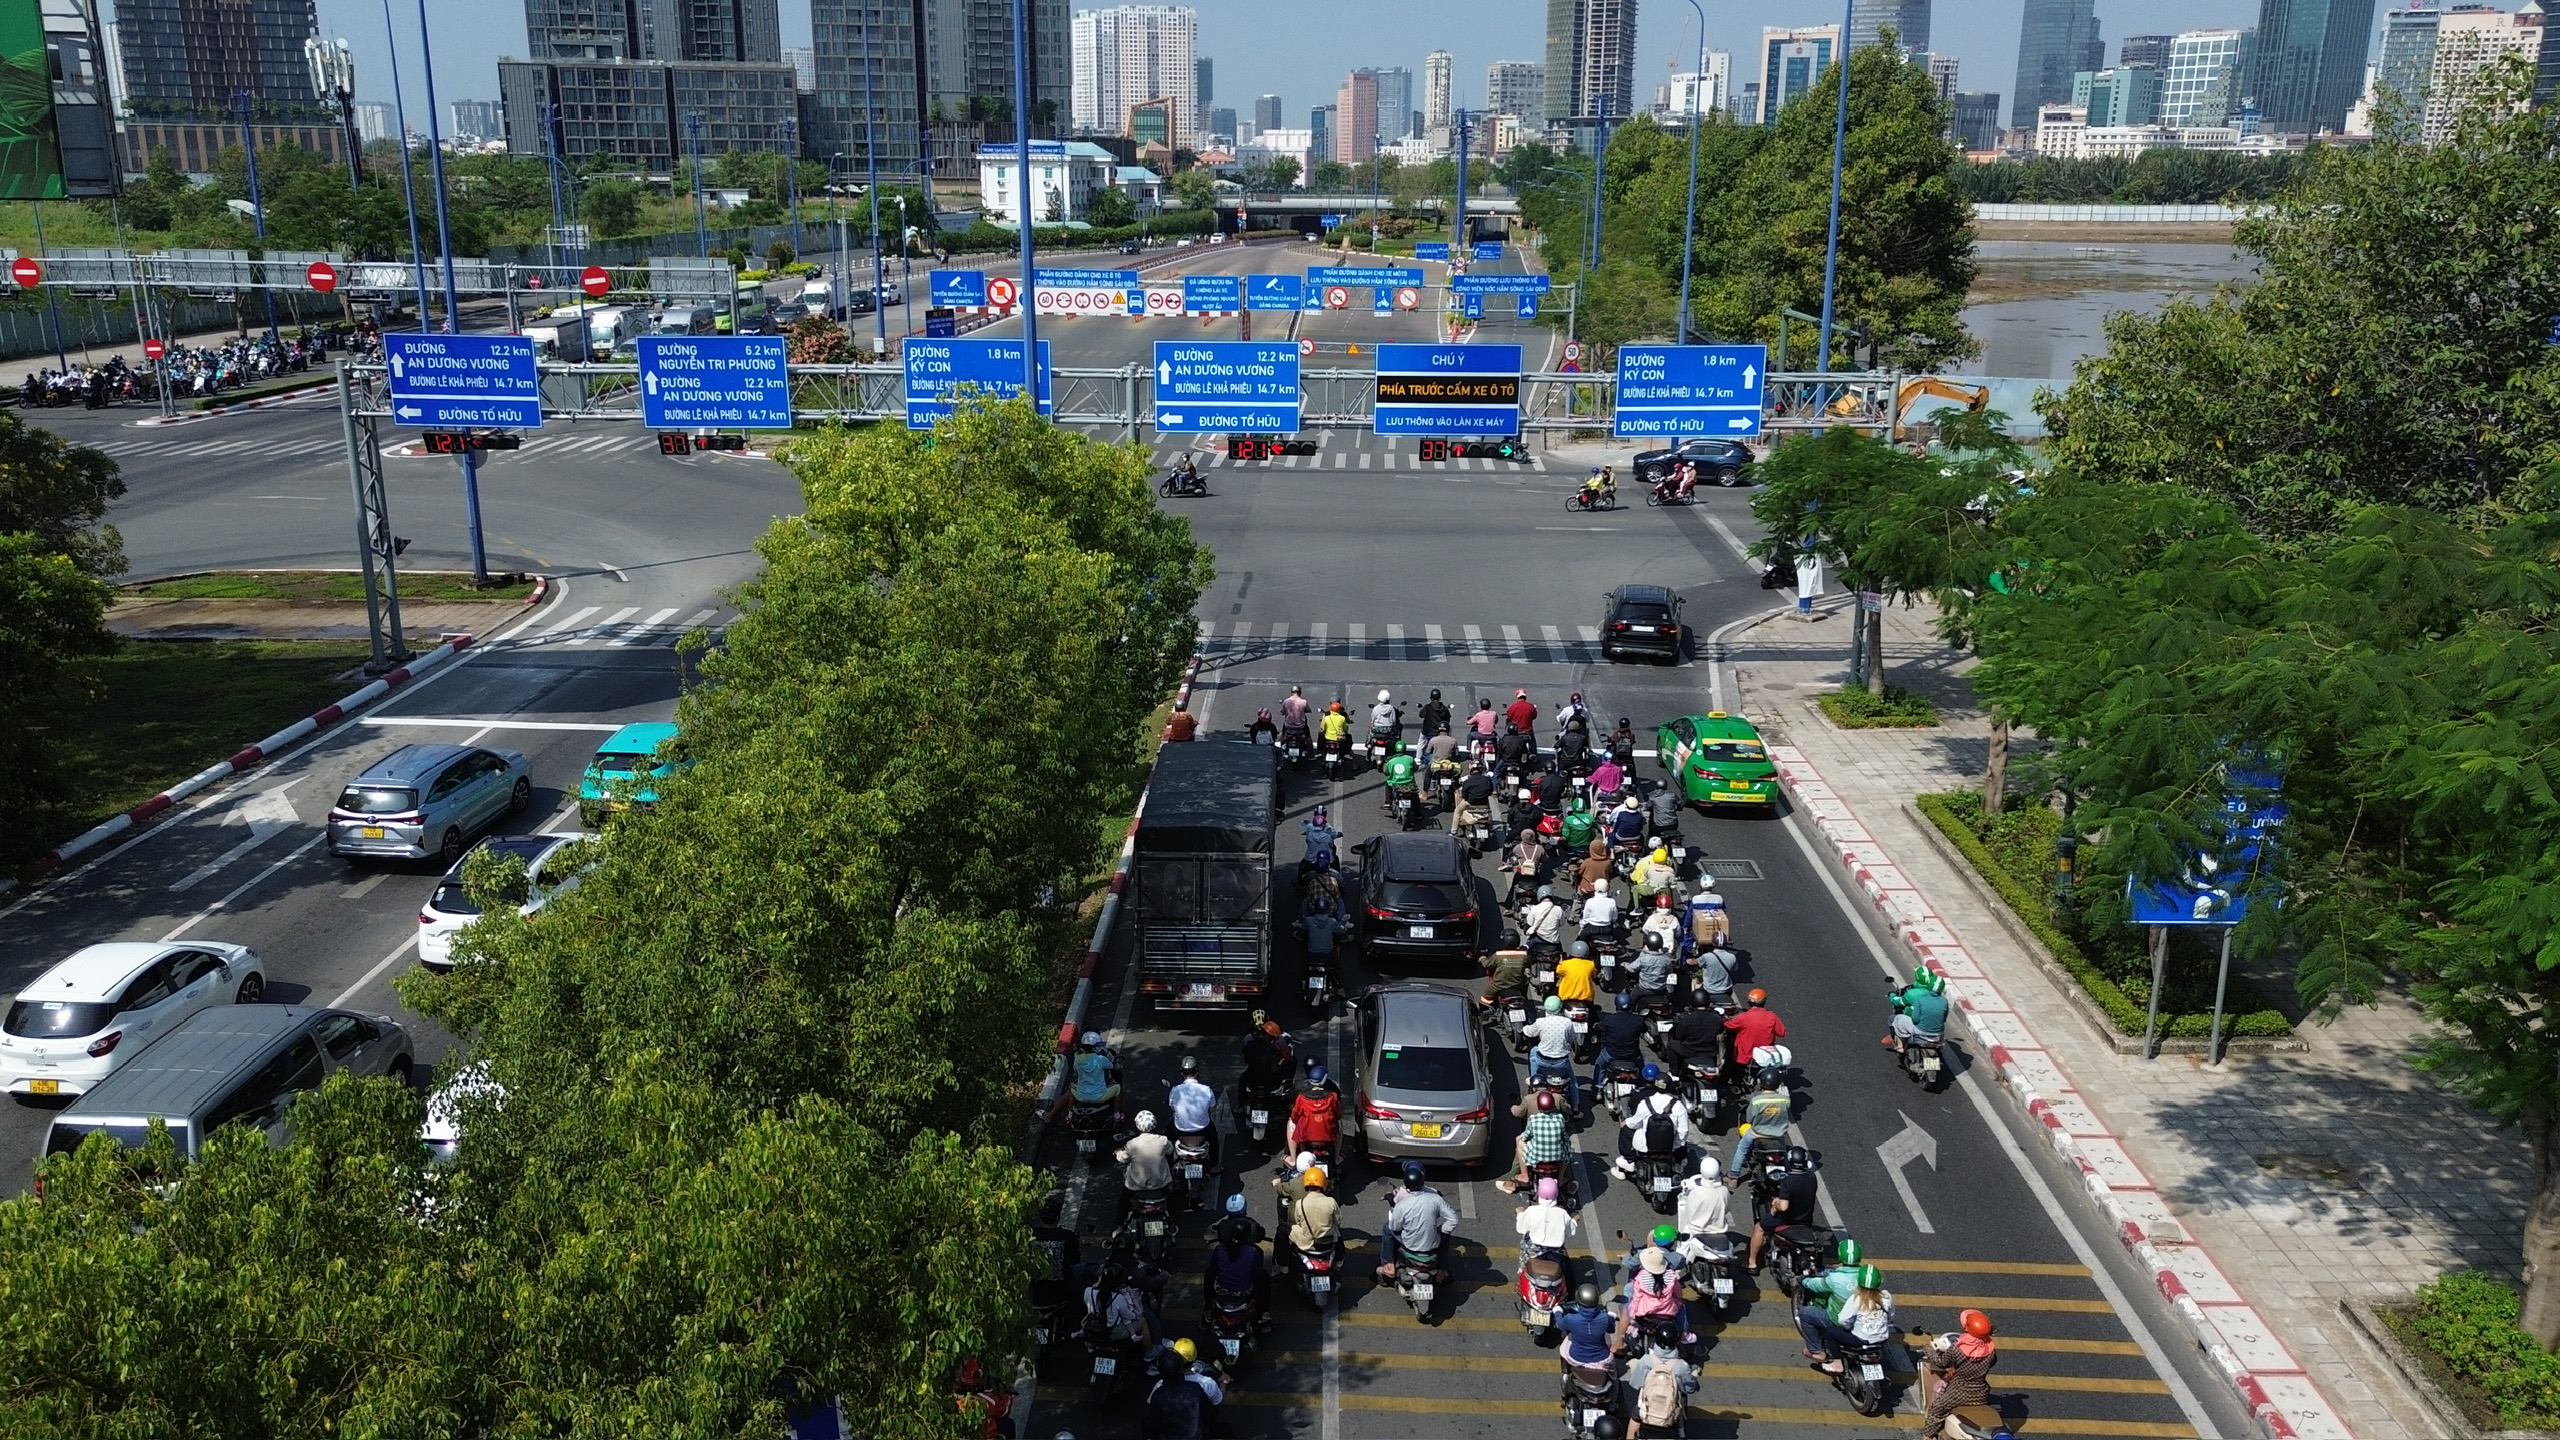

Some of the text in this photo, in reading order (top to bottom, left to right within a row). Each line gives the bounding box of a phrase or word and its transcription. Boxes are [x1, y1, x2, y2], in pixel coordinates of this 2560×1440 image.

[2496, 18, 2505, 26] R
[405, 340, 446, 354] ĐƯỜNG
[490, 345, 530, 356] 12.2 km
[657, 342, 697, 355] ĐƯỜNG
[745, 346, 781, 356] 6.2 km
[910, 344, 950, 358] ĐƯỜNG
[1568, 347, 1576, 356] 50
[988, 349, 1020, 359] 1.8 km
[1174, 348, 1214, 361] ĐƯỜNG
[1257, 351, 1296, 362] 12.2 km
[1432, 352, 1465, 366] CHÚ Ý
[1625, 353, 1665, 367] ĐƯỜNG
[1704, 355, 1736, 366] 1.8 km
[408, 358, 509, 370] AN DƯƠNG VƯƠNG
[659, 356, 776, 370] NGUYỄN TRI PHƯƠNG
[928, 362, 951, 372] CON
[1175, 364, 1274, 376] AN DƯƠNG VƯƠNG
[1625, 368, 1665, 380] KÝ CON
[410, 374, 534, 388] ĐƯỜNG LÊ KHẢ PHIÊU 14.7 km
[661, 375, 700, 388] ĐƯỜNG
[744, 378, 784, 388] 12.2 km
[912, 378, 934, 390] ĐƯỜNG
[936, 378, 944, 390] LÊ
[983, 381, 1002, 391] 14.7
[1176, 381, 1296, 394] ĐƯỜNG LÊ KHẢ PHIÊU 14.7 km
[1380, 381, 1514, 396] PHÍA TRƯỚC CẤM XE Ô TÔ
[1624, 385, 1734, 398] ĐƯỜNG LÊ KHẢ PHIÊU 14.7 km
[664, 391, 763, 401] AN DƯƠNG VƯƠNG
[438, 406, 522, 421] ĐƯỜNG TỐ HỮU
[664, 407, 786, 420] ĐƯỜNG LÊ KHẢ PHIÊU 14.7 km
[1199, 413, 1281, 427] ĐƯỜNG TỐ HỮU
[1386, 416, 1504, 427] LƯU THÔNG VÀO LÀN XE MÁY
[1621, 417, 1704, 431] ĐƯỜNG TỐ HỮU
[434, 434, 465, 452] 121
[1238, 441, 1266, 459] 121
